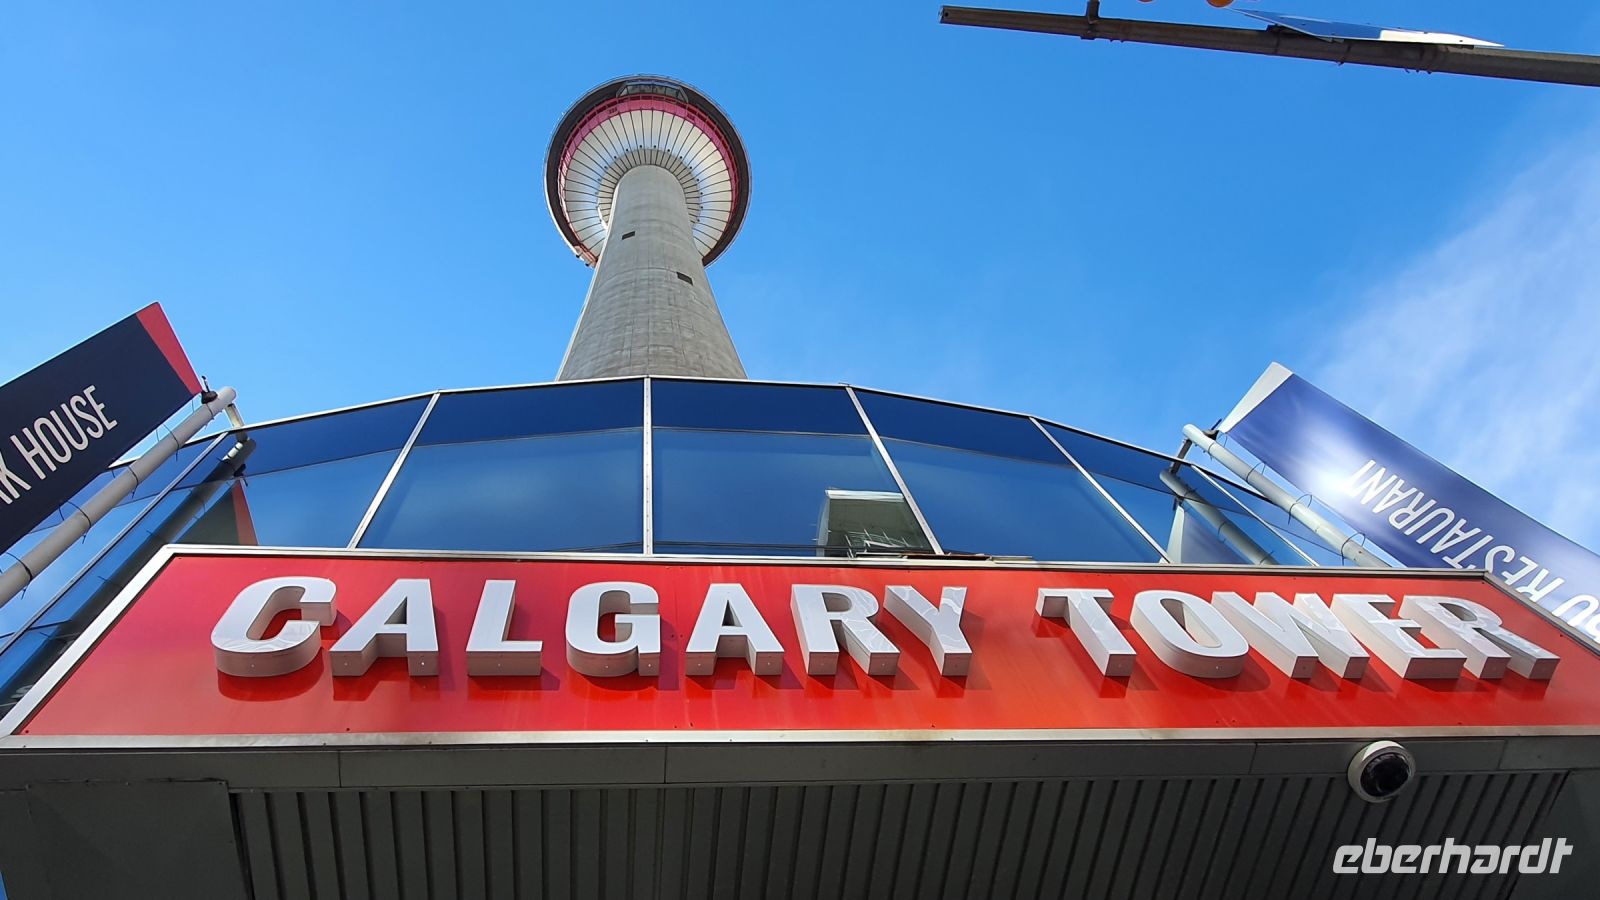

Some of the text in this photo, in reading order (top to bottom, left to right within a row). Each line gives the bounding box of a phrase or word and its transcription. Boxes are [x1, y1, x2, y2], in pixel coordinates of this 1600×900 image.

[0, 384, 118, 505] K HOUSE
[210, 576, 1561, 680] CALGARY TOWER
